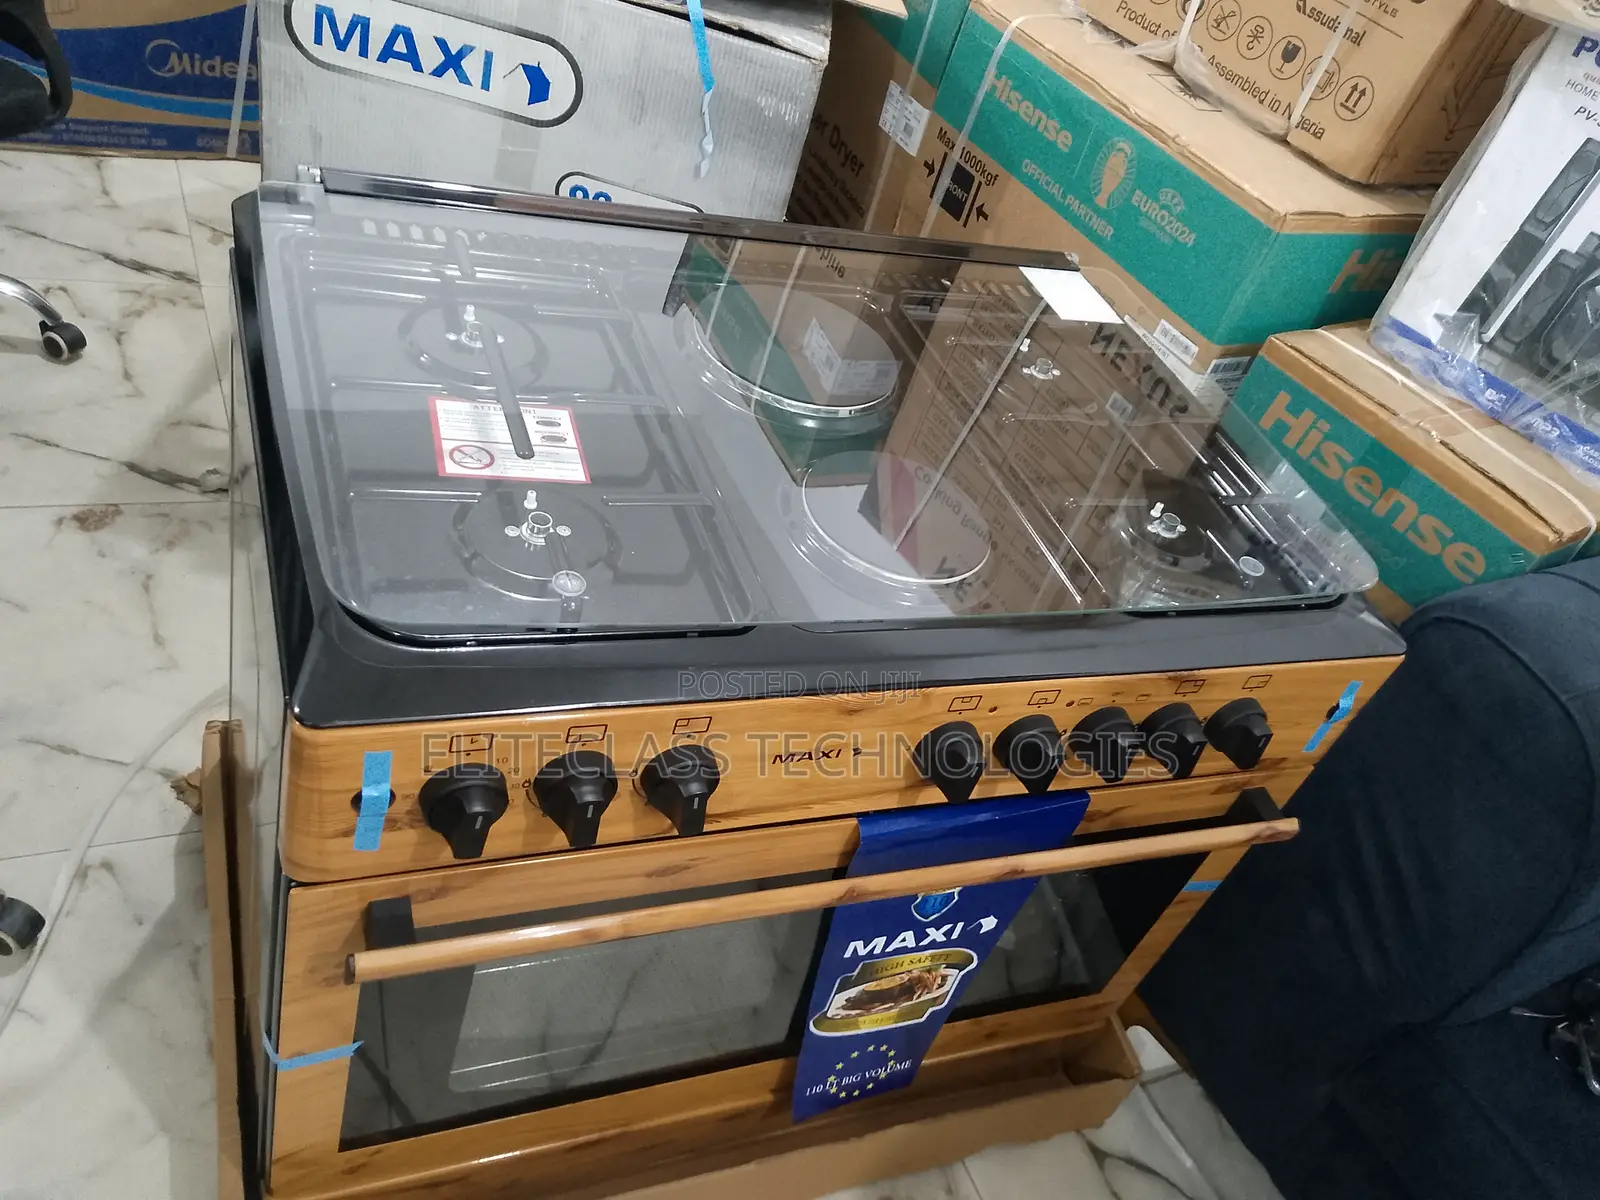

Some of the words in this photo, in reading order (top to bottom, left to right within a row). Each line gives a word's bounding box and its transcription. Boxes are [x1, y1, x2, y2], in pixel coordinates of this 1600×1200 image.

[313, 4, 496, 92] MAXI
[1116, 4, 1162, 38] Product
[984, 71, 1073, 153] Hisense
[1207, 54, 1267, 105] Assembled
[1267, 92, 1281, 114] in
[829, 124, 865, 178] Dryer
[936, 127, 955, 152] Max
[960, 147, 1000, 187] 1000kgf
[1021, 159, 1065, 202] OFFICIAL
[1063, 194, 1115, 241] PARTNER
[1131, 189, 1197, 247] EURO2024
[1259, 391, 1486, 584] Hisense
[771, 748, 843, 765] MAXI
[843, 921, 965, 959] MAXI
[806, 1083, 823, 1097] 110
[841, 1072, 862, 1087] BIG
[864, 1058, 913, 1079] VOLUME
